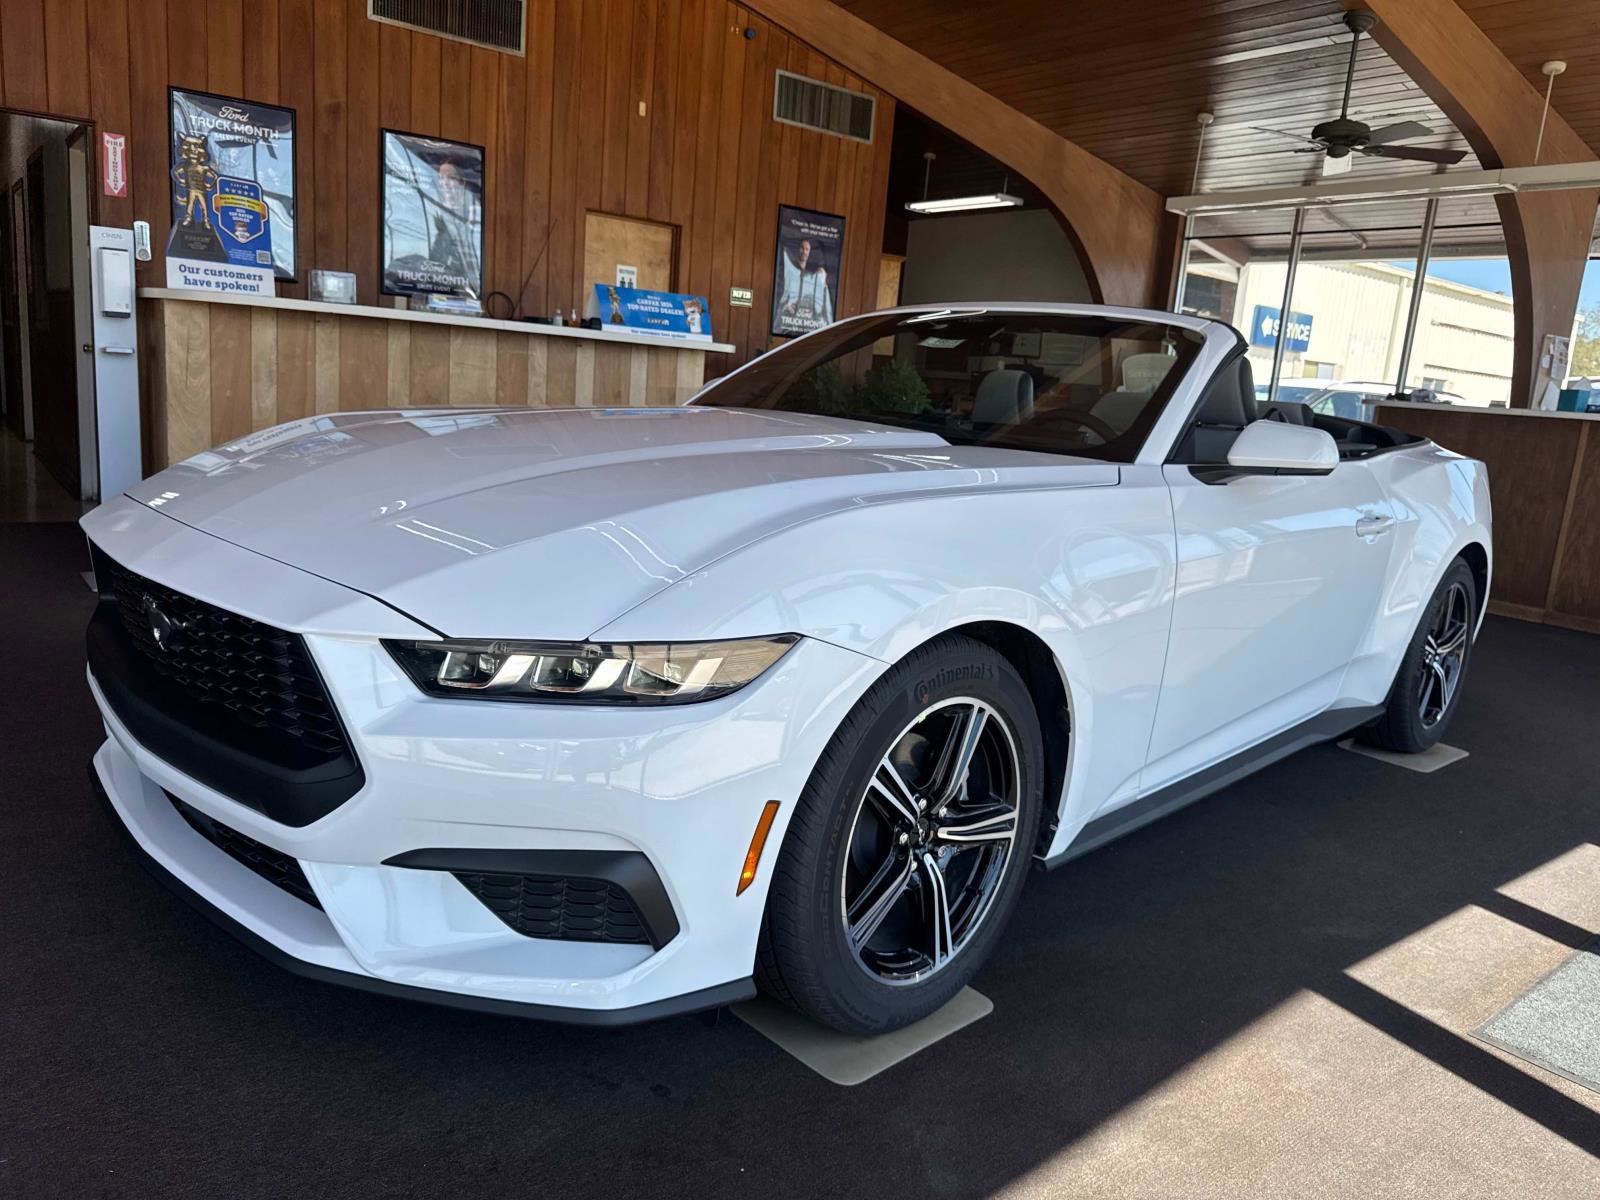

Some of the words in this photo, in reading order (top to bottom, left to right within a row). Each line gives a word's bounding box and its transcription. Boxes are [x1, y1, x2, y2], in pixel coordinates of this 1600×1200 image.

[219, 106, 249, 122] Ford
[189, 115, 232, 132] TRUCK
[234, 123, 279, 140] MONTH
[179, 264, 201, 274] Our
[203, 267, 263, 281] customers
[421, 261, 447, 272] Ford
[183, 275, 212, 287] have
[215, 280, 260, 292] spoken!
[397, 270, 431, 281] TRUCK
[432, 274, 469, 286] MONTH
[781, 316, 803, 326] TRUCK
[914, 663, 986, 704] Continental
